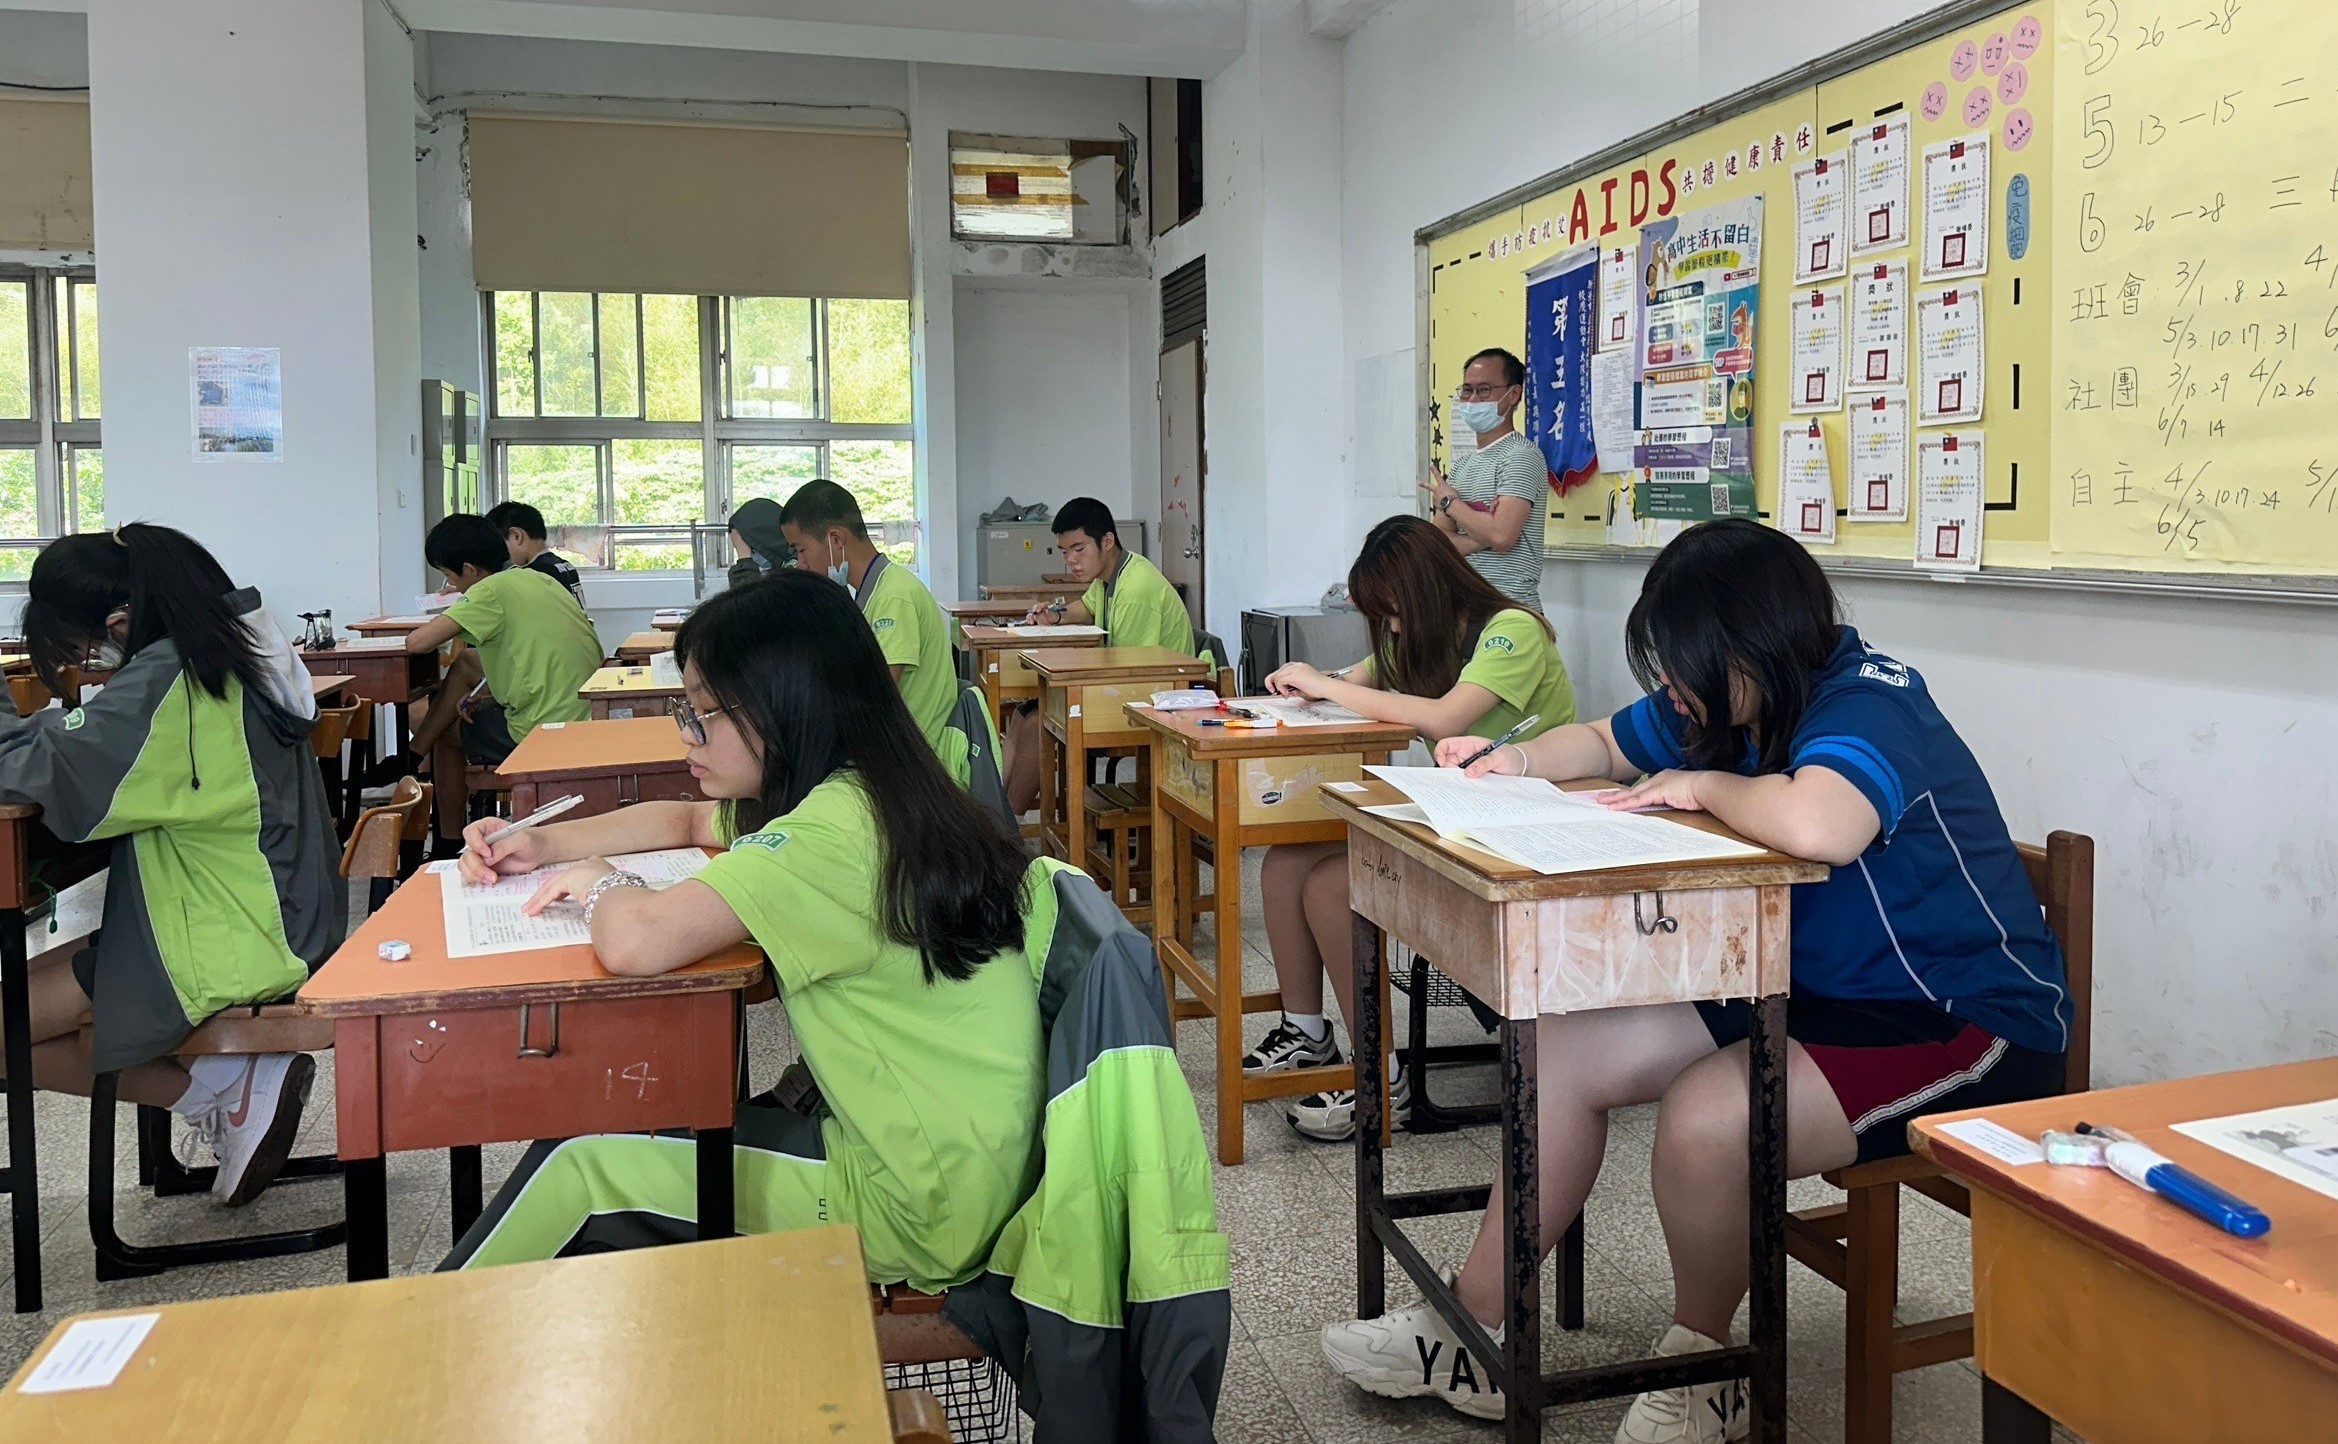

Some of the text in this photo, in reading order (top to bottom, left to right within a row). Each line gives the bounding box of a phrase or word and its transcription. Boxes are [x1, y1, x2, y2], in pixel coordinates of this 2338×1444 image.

[2083, 94, 2114, 169] 5
[1569, 158, 1677, 246] AIDS
[1667, 224, 1750, 262] 高中生活不留白
[1488, 638, 1510, 647] 0210
[742, 835, 782, 845] 0207
[1415, 1335, 1498, 1394] YA
